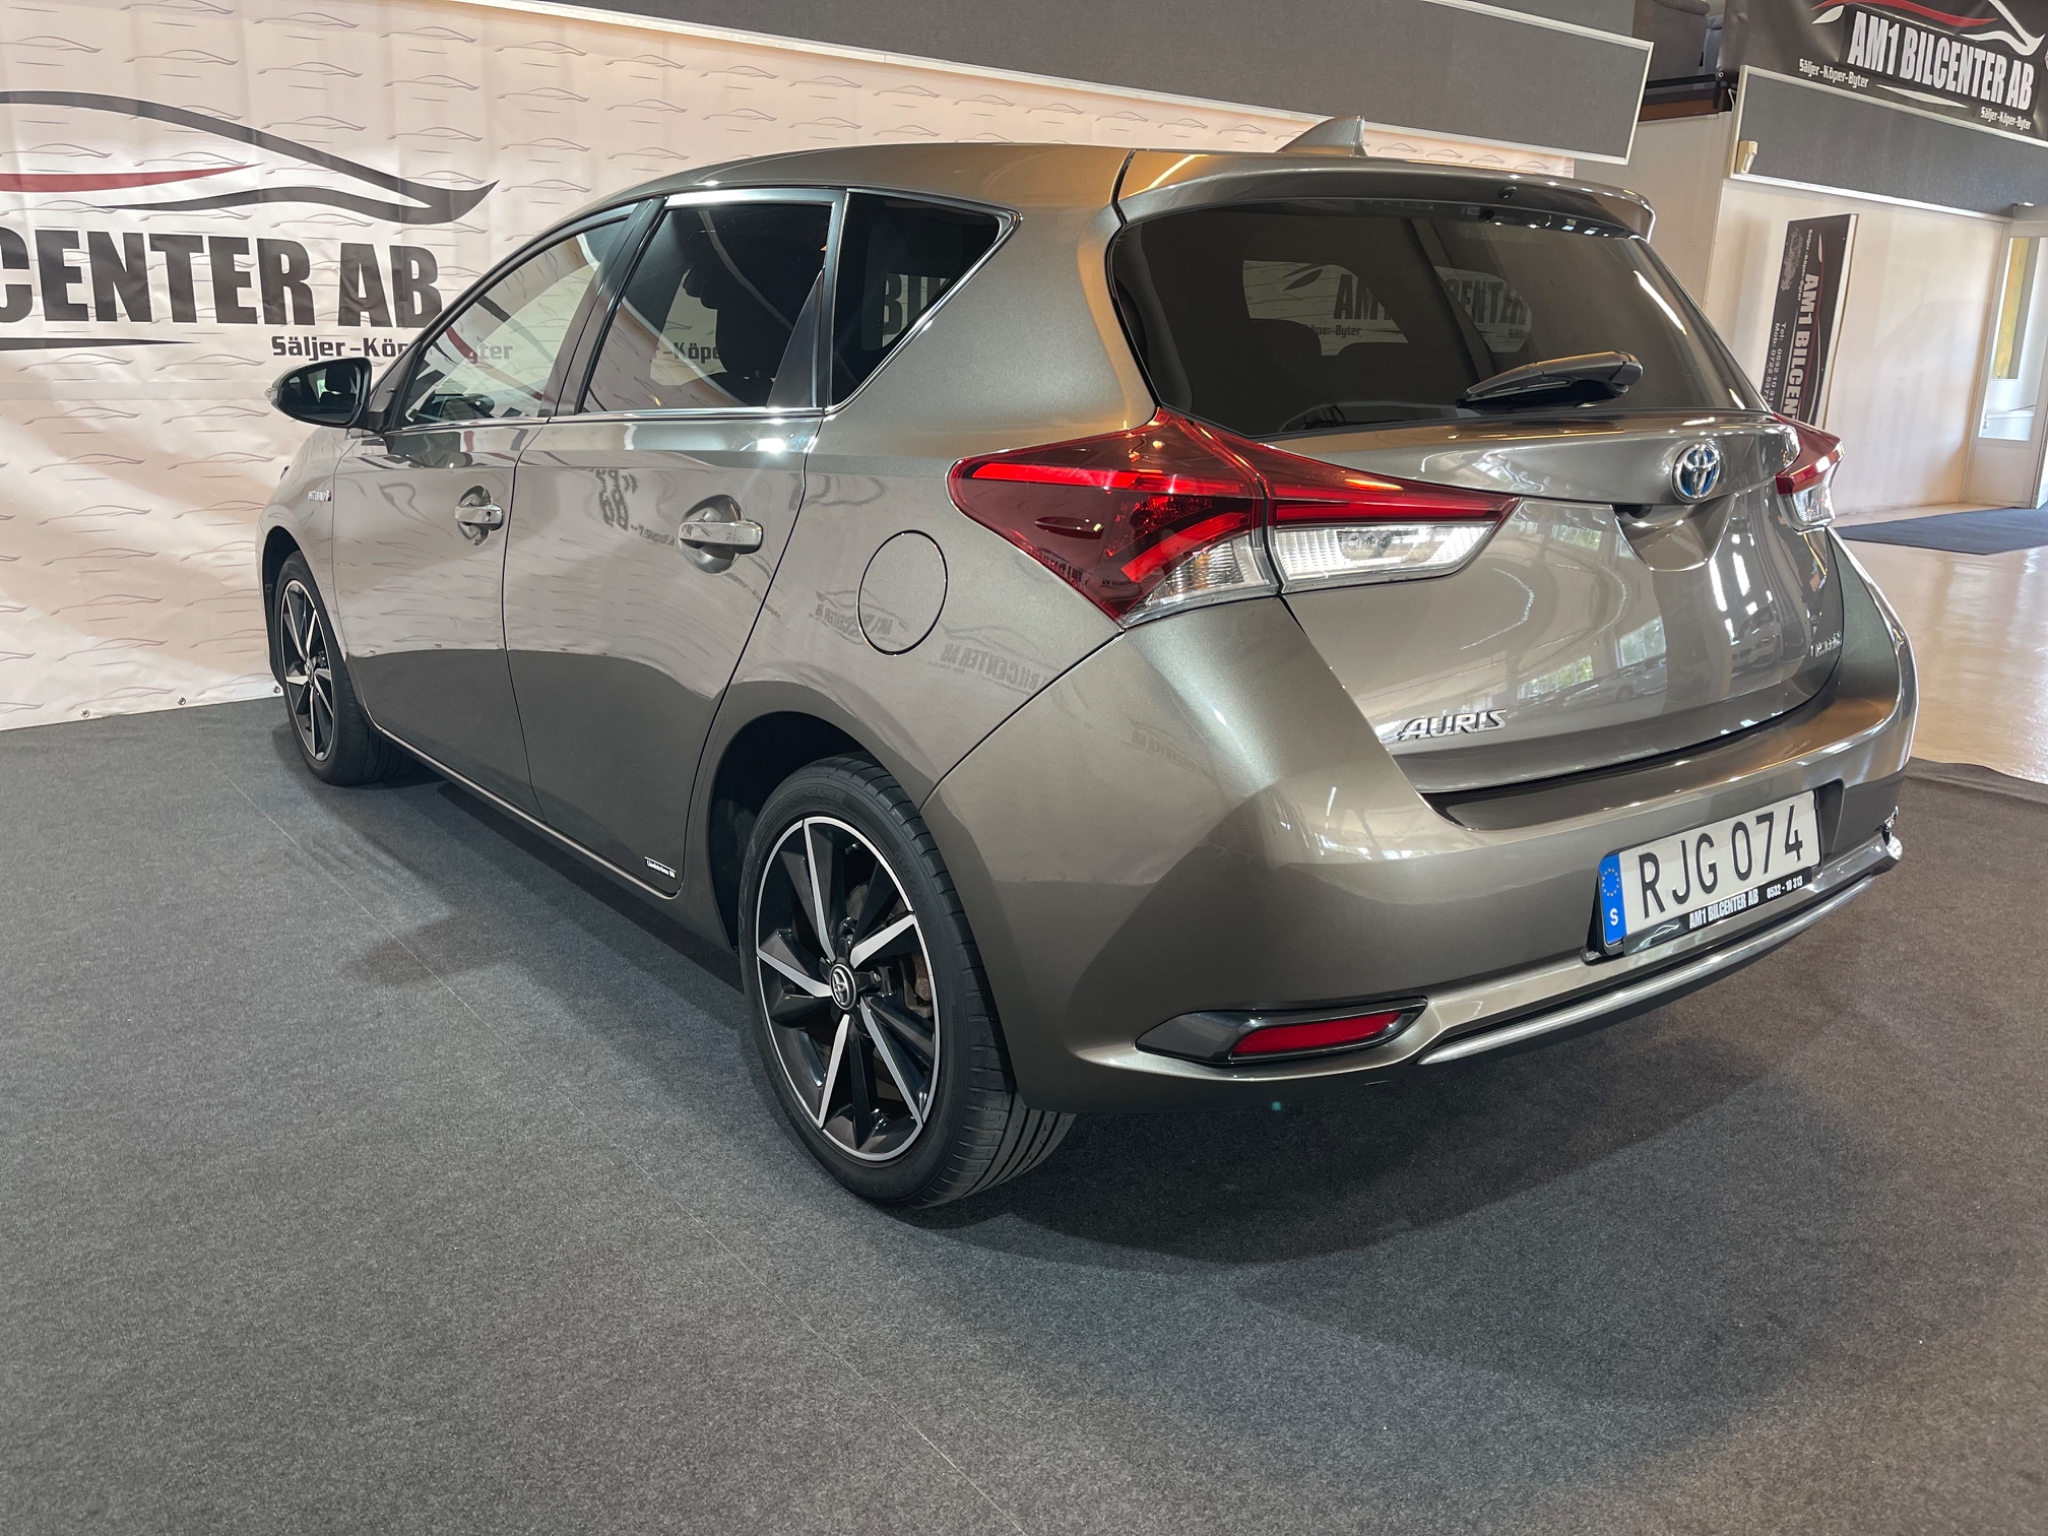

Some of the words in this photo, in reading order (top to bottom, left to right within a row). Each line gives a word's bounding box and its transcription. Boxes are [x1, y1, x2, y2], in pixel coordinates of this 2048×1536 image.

[1847, 10, 1900, 76] AM1
[1899, 26, 2008, 105] BILCENTER
[2005, 60, 2035, 111] AB
[338, 242, 443, 328] AB
[1798, 273, 1820, 326] AM1
[1397, 708, 1508, 740] AURIS
[1638, 833, 1718, 919] RJG
[1731, 804, 1803, 882] 074
[1609, 908, 1618, 926] S
[1689, 907, 1707, 930] AM1
[1708, 893, 1747, 922] BILCENTER
[1747, 888, 1759, 907] AB
